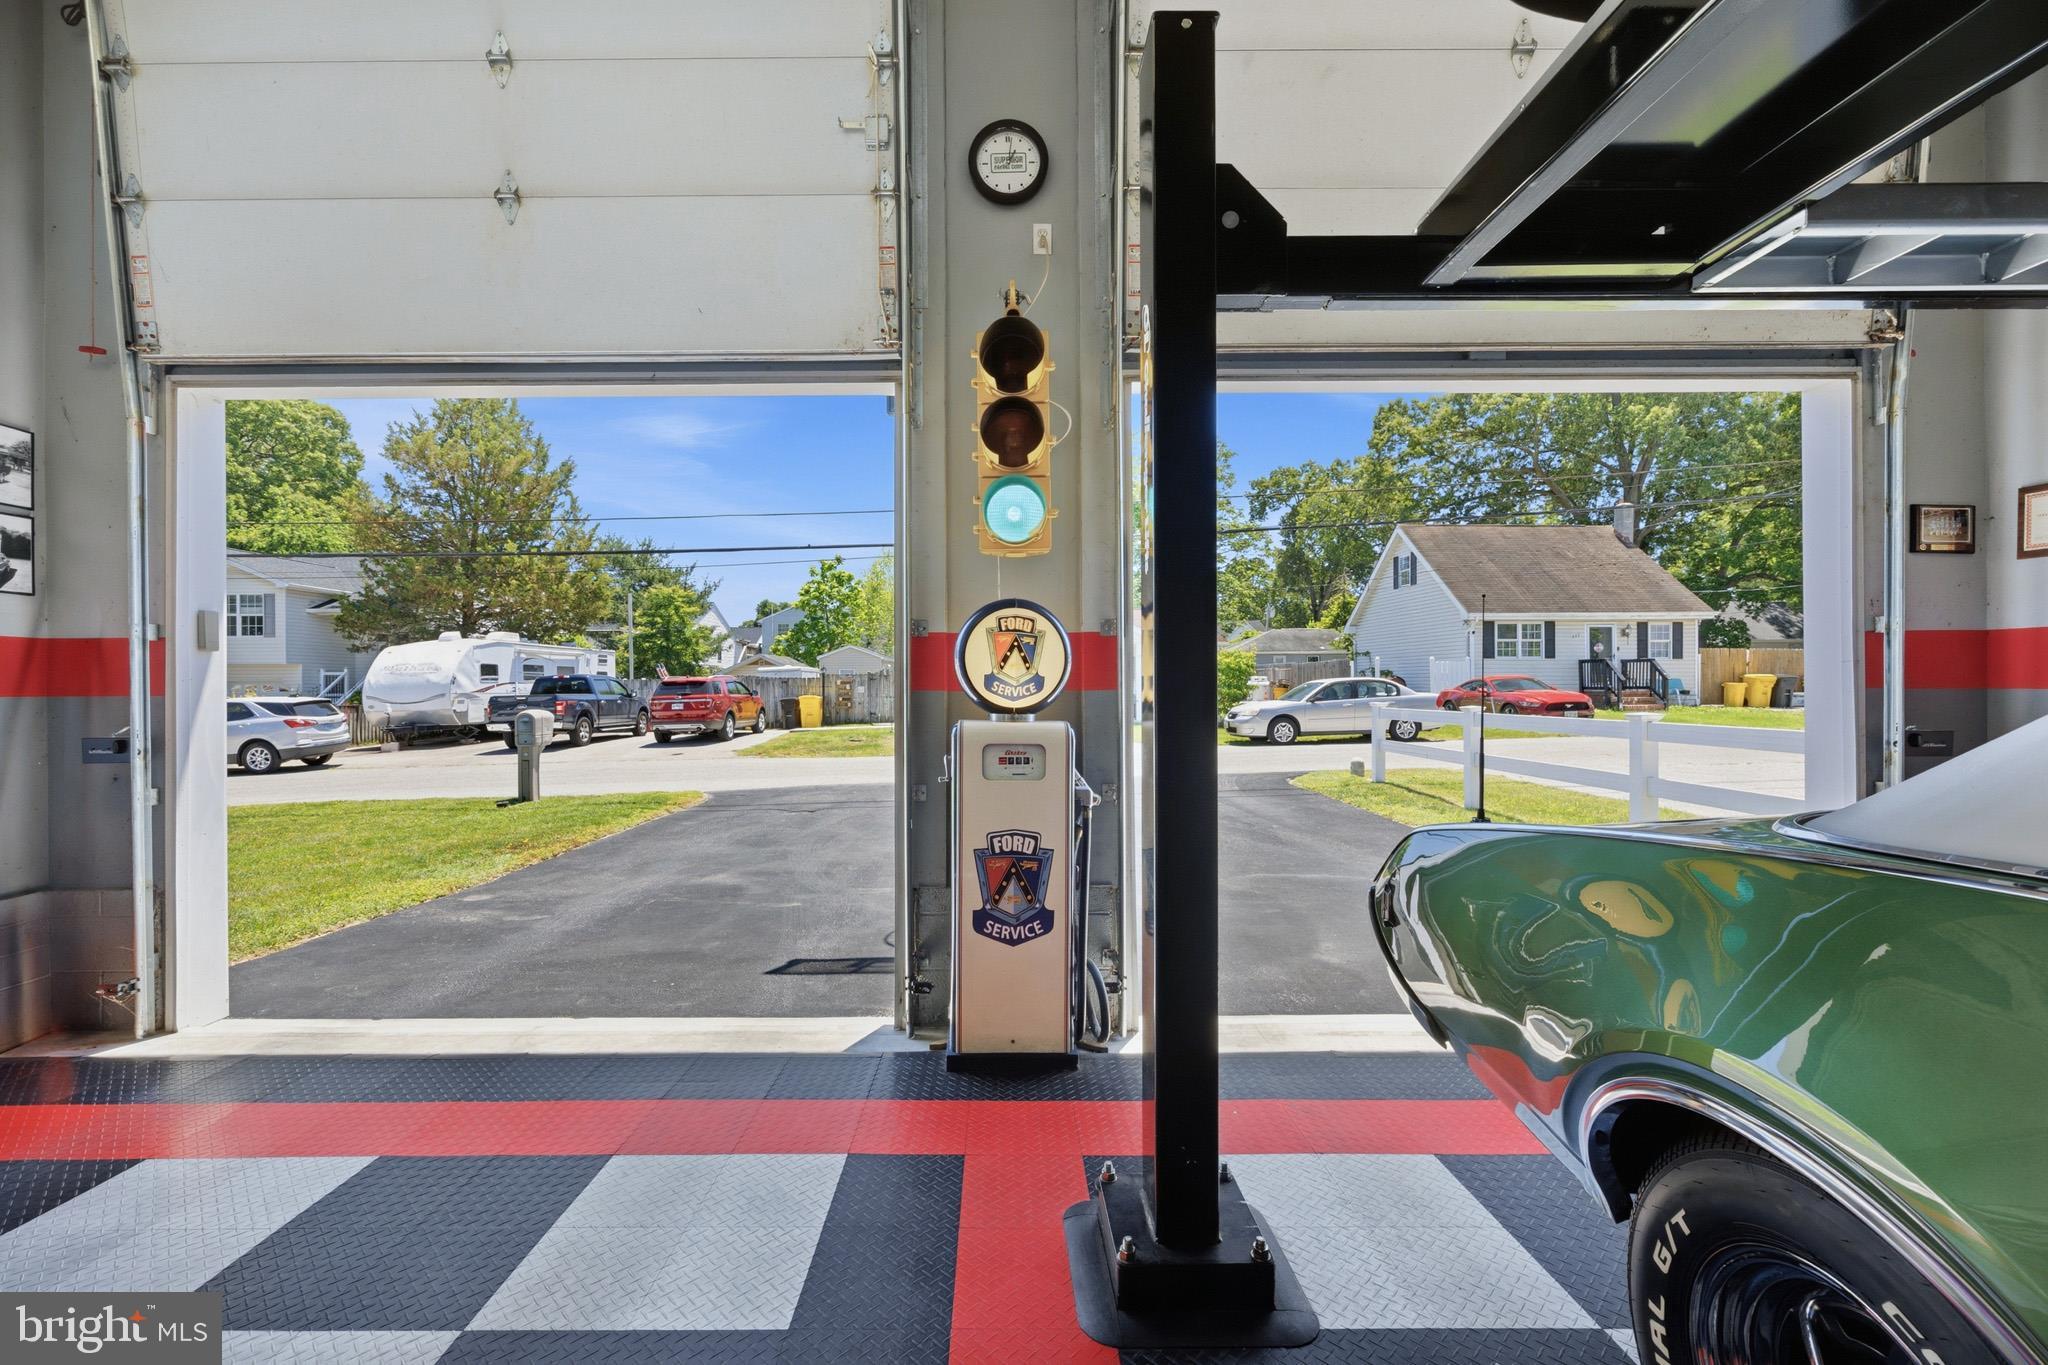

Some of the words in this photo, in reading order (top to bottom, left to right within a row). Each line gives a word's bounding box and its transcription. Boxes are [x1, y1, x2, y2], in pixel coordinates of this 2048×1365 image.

[1000, 617, 1034, 633] FORD
[991, 681, 1037, 697] SERVICE
[992, 835, 1036, 855] FORD
[983, 919, 1045, 940] SERVICE
[1652, 1208, 1691, 1275] G/T
